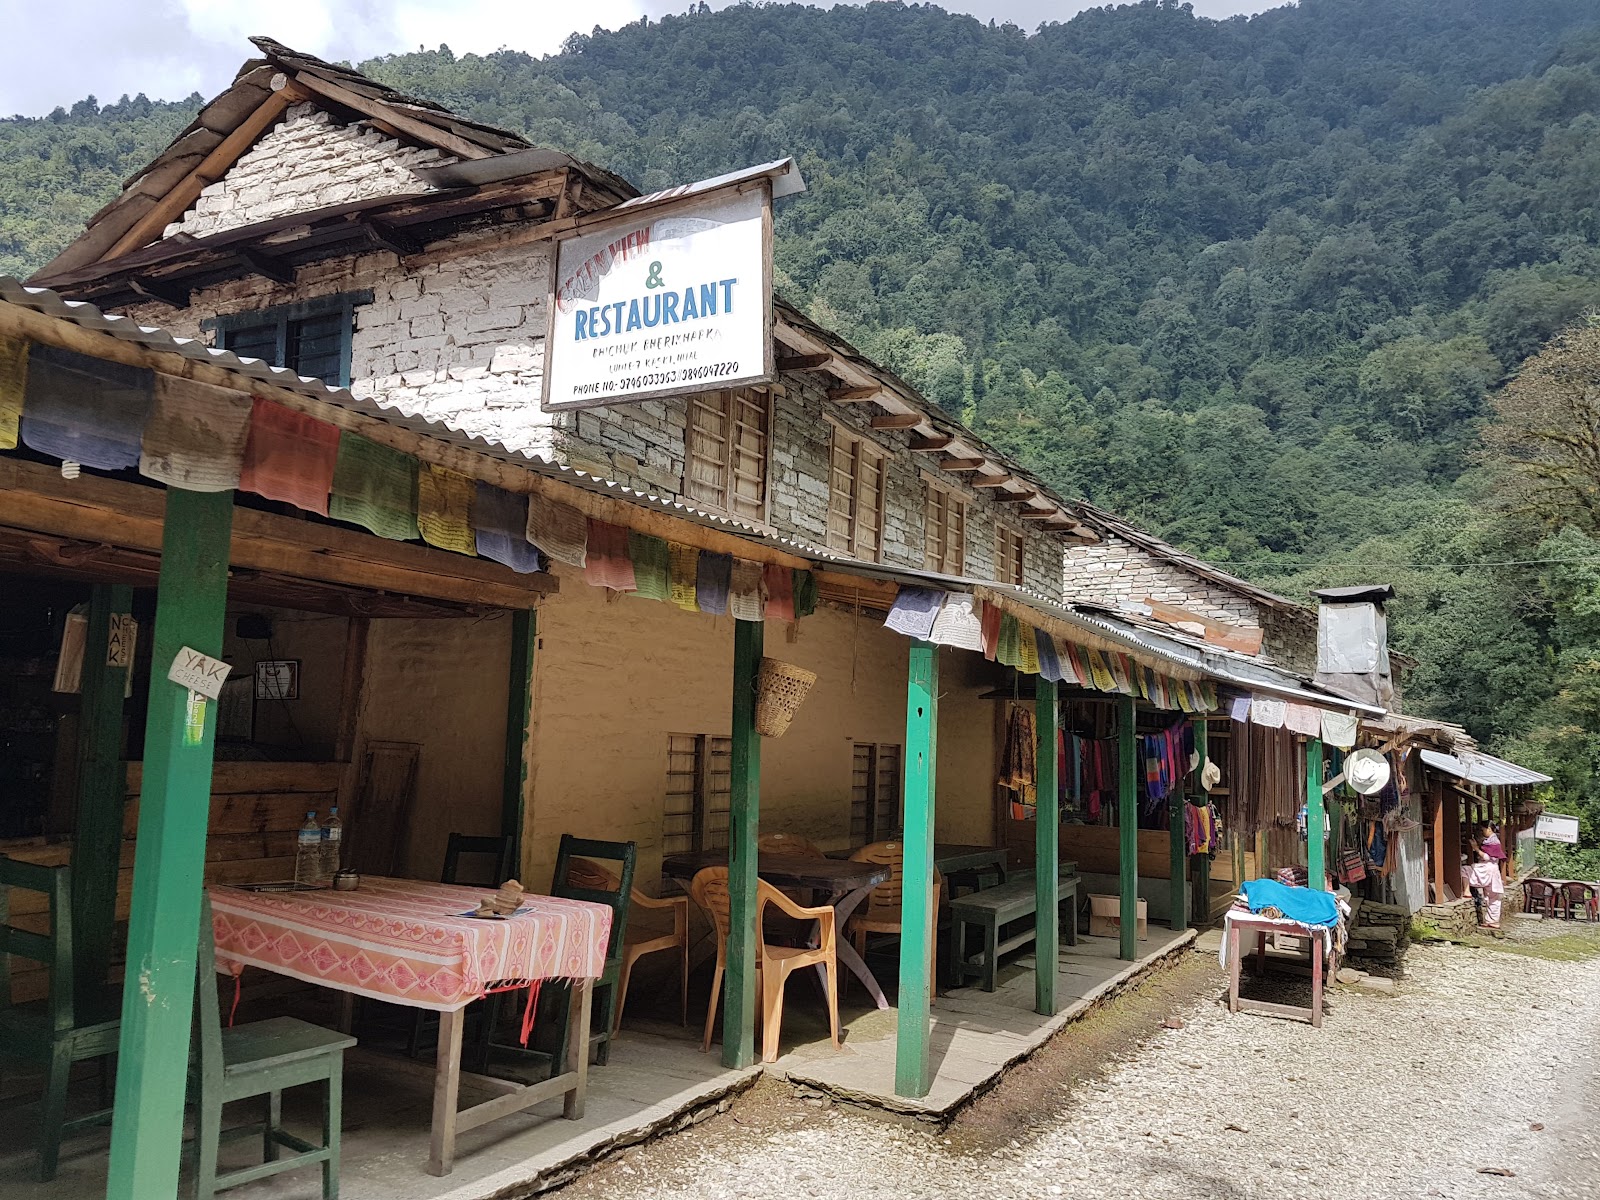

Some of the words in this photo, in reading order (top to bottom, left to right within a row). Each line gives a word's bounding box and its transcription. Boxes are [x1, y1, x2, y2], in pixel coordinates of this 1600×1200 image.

[645, 261, 666, 289] &
[574, 278, 738, 342] RESTAURANT
[573, 382, 600, 395] PHONE
[109, 617, 120, 663] NAK
[175, 669, 212, 690] CHEESE
[185, 651, 226, 681] YAK
